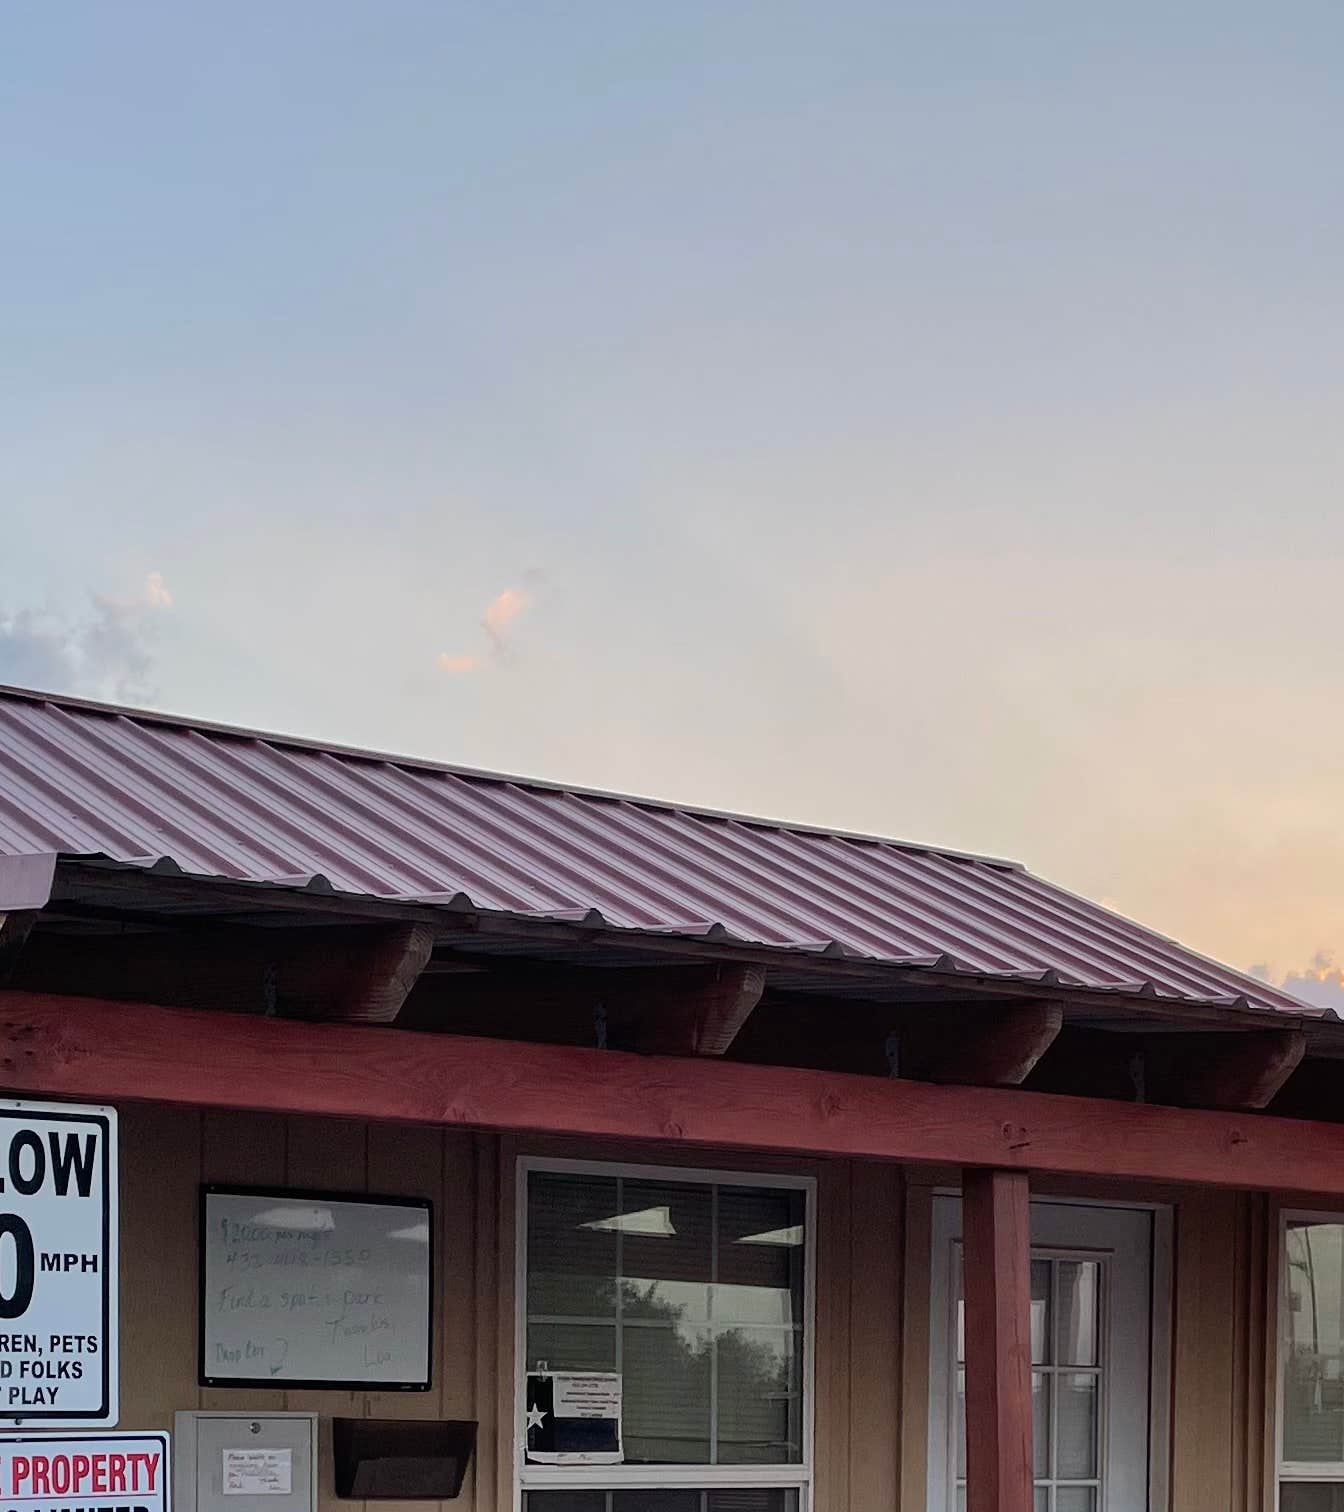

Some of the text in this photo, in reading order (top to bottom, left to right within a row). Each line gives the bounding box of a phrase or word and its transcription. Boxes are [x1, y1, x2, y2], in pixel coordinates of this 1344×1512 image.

[40, 1252, 99, 1273] MPH
[49, 1335, 98, 1353] PETS
[19, 1361, 83, 1380] FOLKS
[8, 1387, 60, 1406] PLAY
[11, 1452, 161, 1496] PROPERTY
